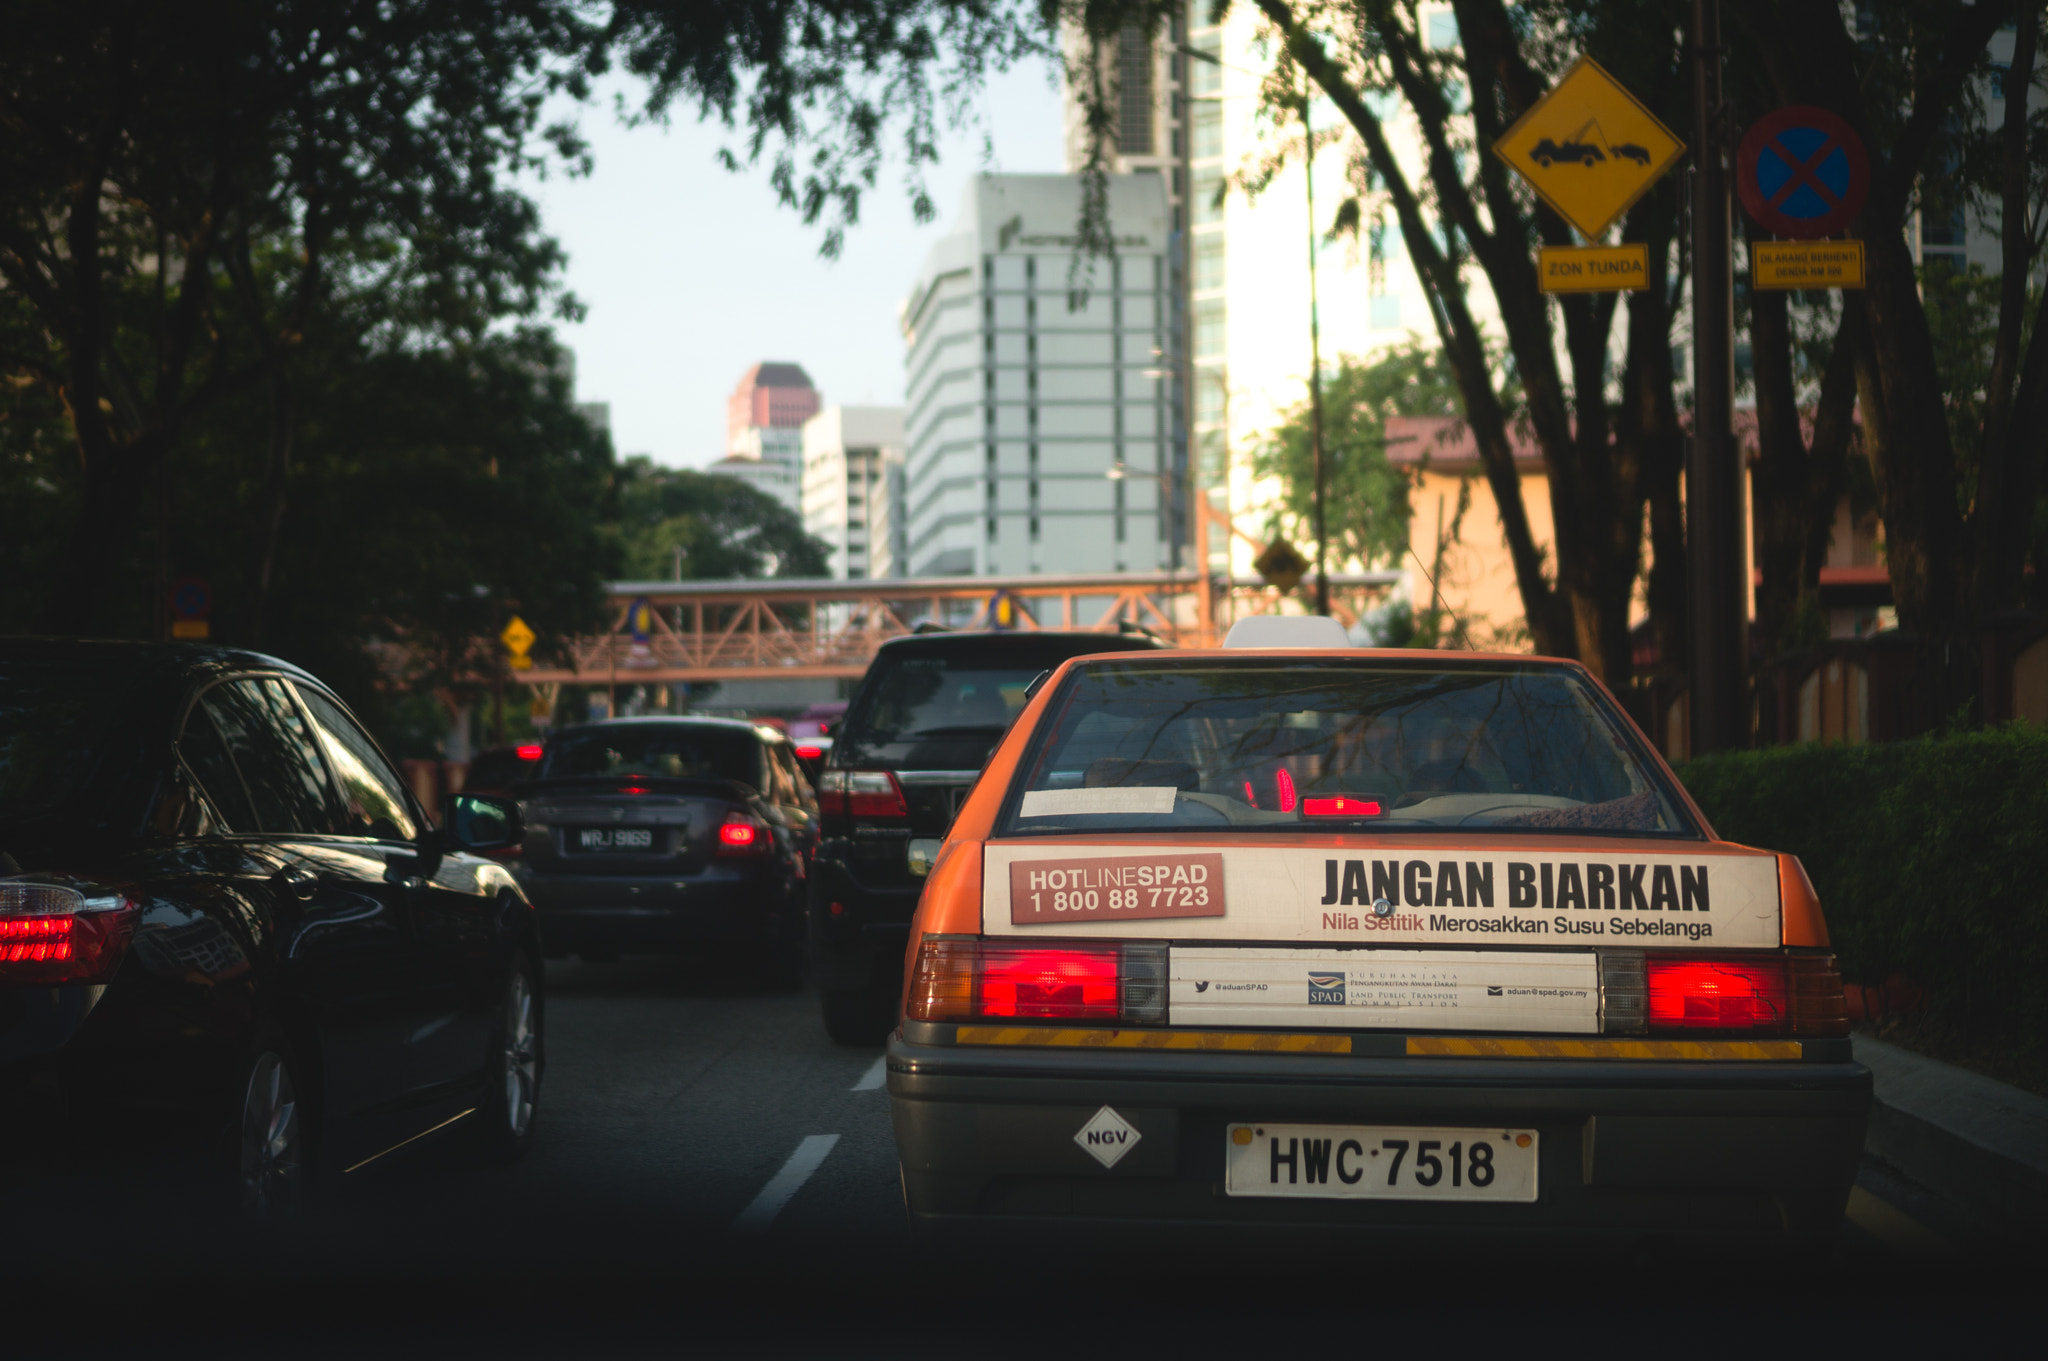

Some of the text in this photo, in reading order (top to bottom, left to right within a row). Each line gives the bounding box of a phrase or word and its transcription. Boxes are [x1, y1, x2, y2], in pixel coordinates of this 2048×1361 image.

[1549, 259, 1643, 276] ZON TUNDA
[581, 829, 652, 847] WRJ 9169
[1321, 859, 1495, 908] JANGAN
[1508, 861, 1711, 912] BIARKAN
[1030, 892, 1041, 913] 1
[1054, 890, 1099, 912] 800
[1109, 888, 1139, 909] 88
[1147, 886, 1209, 908] 7723
[1322, 912, 1713, 940] Nila Setitik Merosakkan Susu Sebelanga
[1215, 983, 1269, 992] @aduanSPAD
[1351, 991, 1373, 999] LAND
[1378, 991, 1407, 999] PUBLIC
[1507, 988, 1588, 998] aduan@spad.gov.my
[1311, 991, 1344, 1003] SPAD
[1350, 1000, 1459, 1008] COMMISSION
[1087, 1130, 1128, 1145] NGV
[1270, 1137, 1495, 1187] HWC 7518
